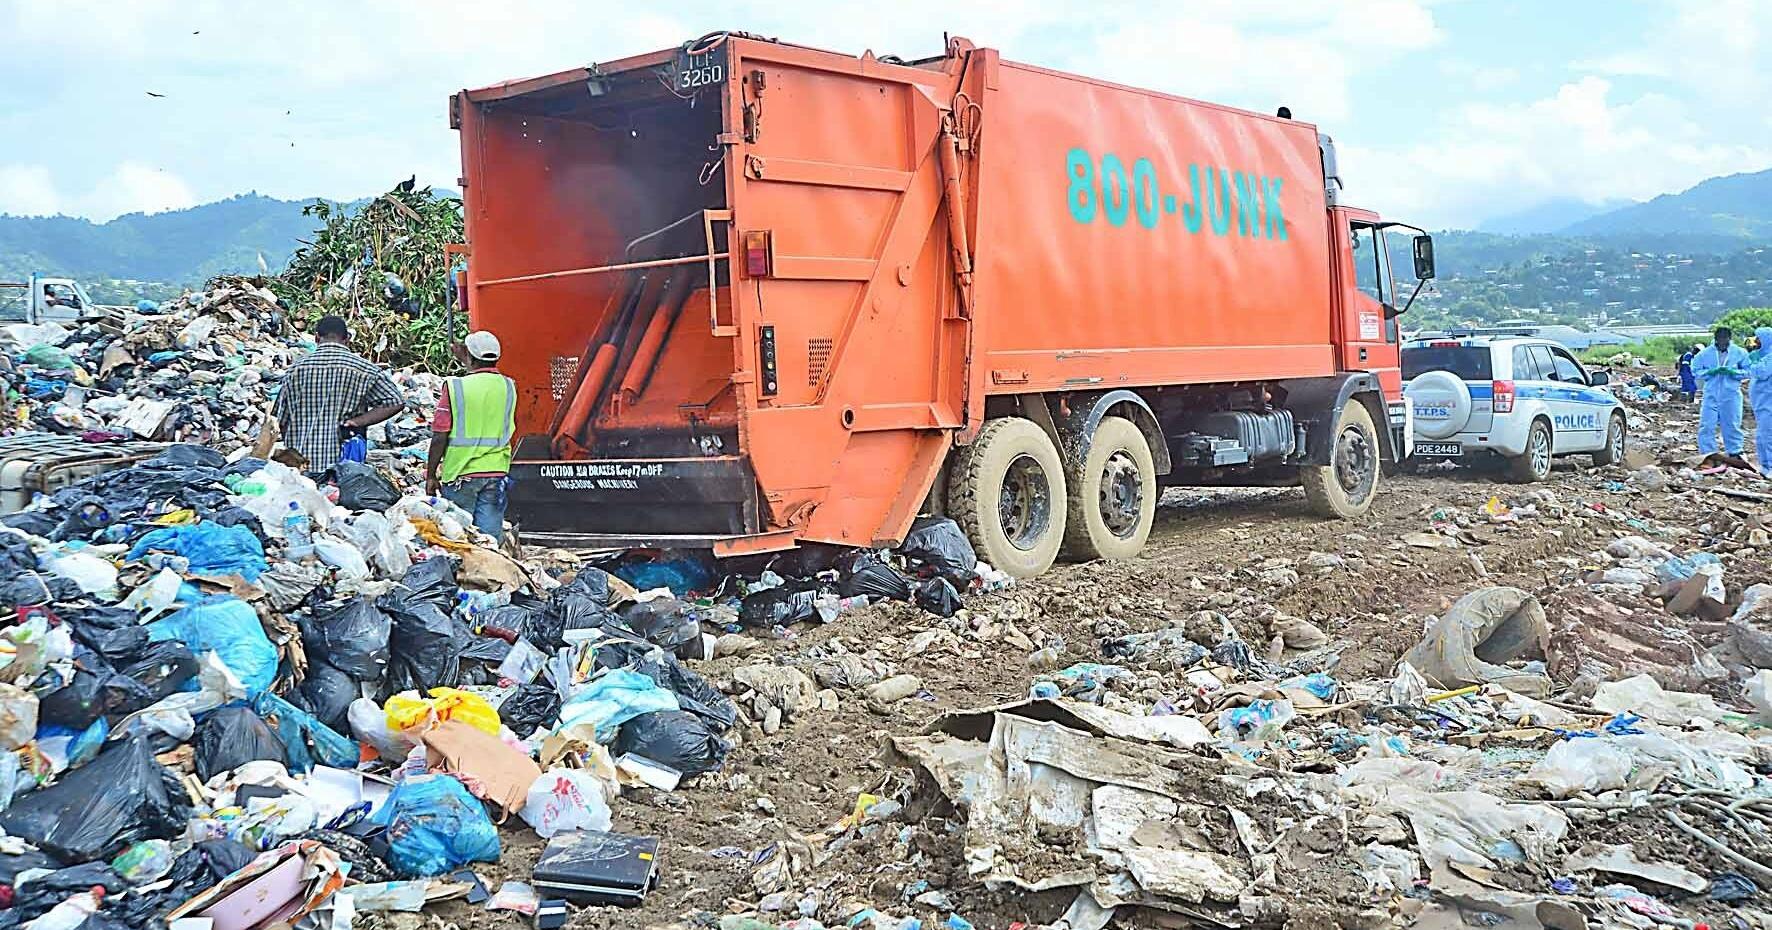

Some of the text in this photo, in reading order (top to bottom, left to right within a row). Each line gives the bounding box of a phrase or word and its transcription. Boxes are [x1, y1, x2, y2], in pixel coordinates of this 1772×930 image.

[681, 65, 721, 88] 3260
[1066, 147, 1288, 241] 800-JUNK
[1554, 414, 1594, 429] POLICE
[540, 465, 574, 477] CAUTION
[552, 479, 639, 490] DANGEROUS MACHINERY
